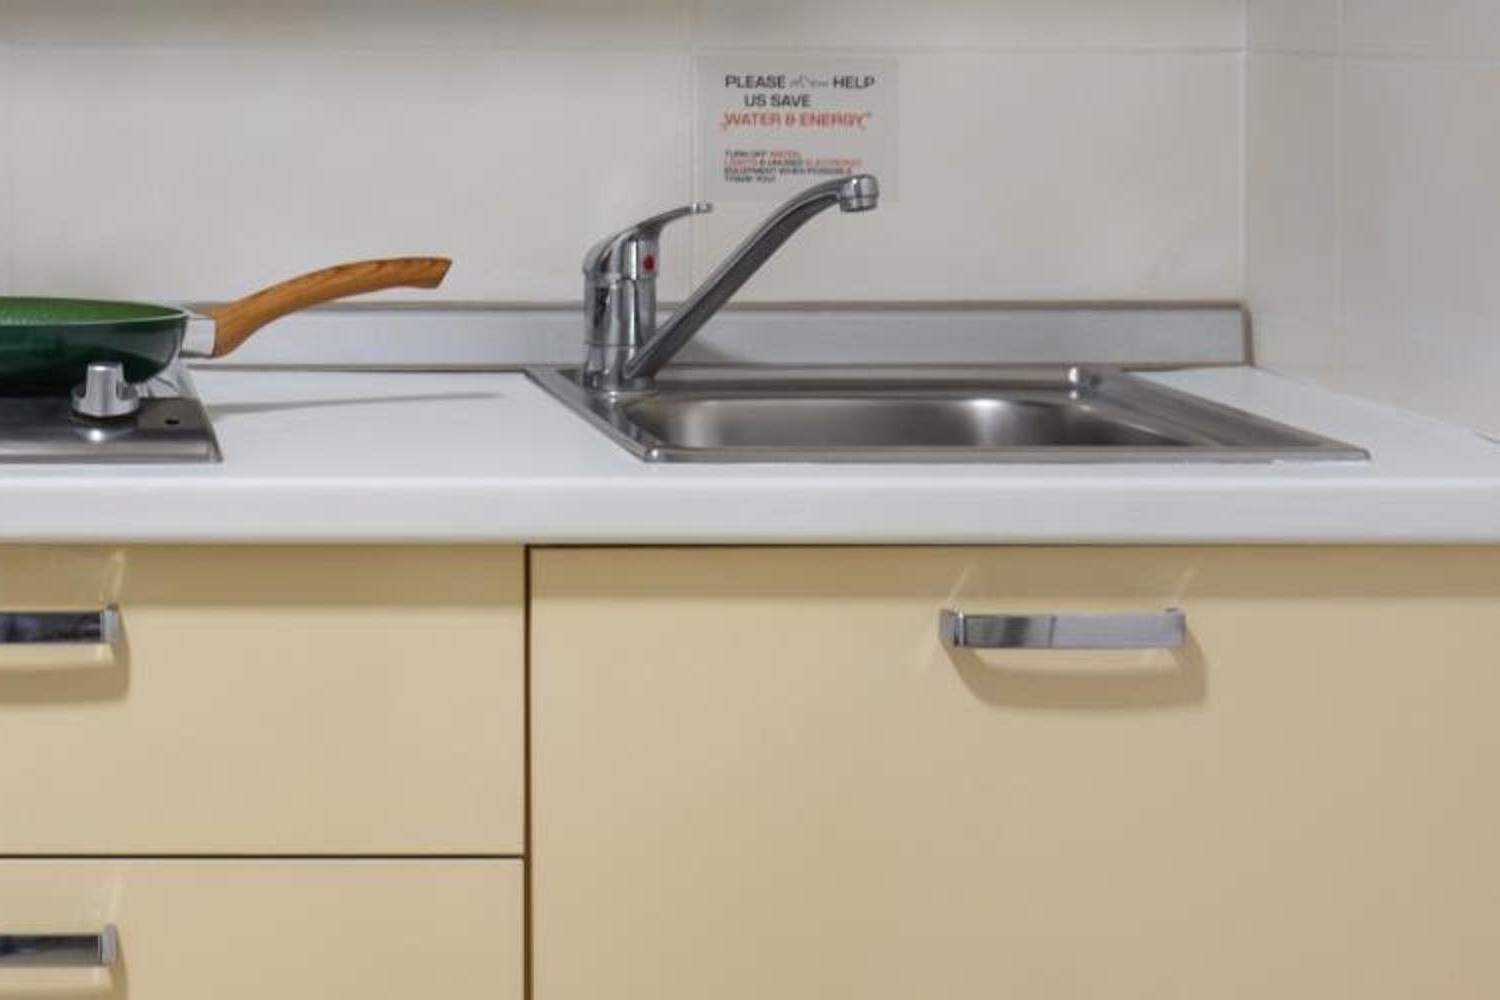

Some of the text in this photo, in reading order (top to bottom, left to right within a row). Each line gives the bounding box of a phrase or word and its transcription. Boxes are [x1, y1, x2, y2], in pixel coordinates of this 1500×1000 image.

[724, 74, 786, 89] PLEASE
[833, 74, 875, 89] HELP
[744, 93, 812, 107] US SAVE
